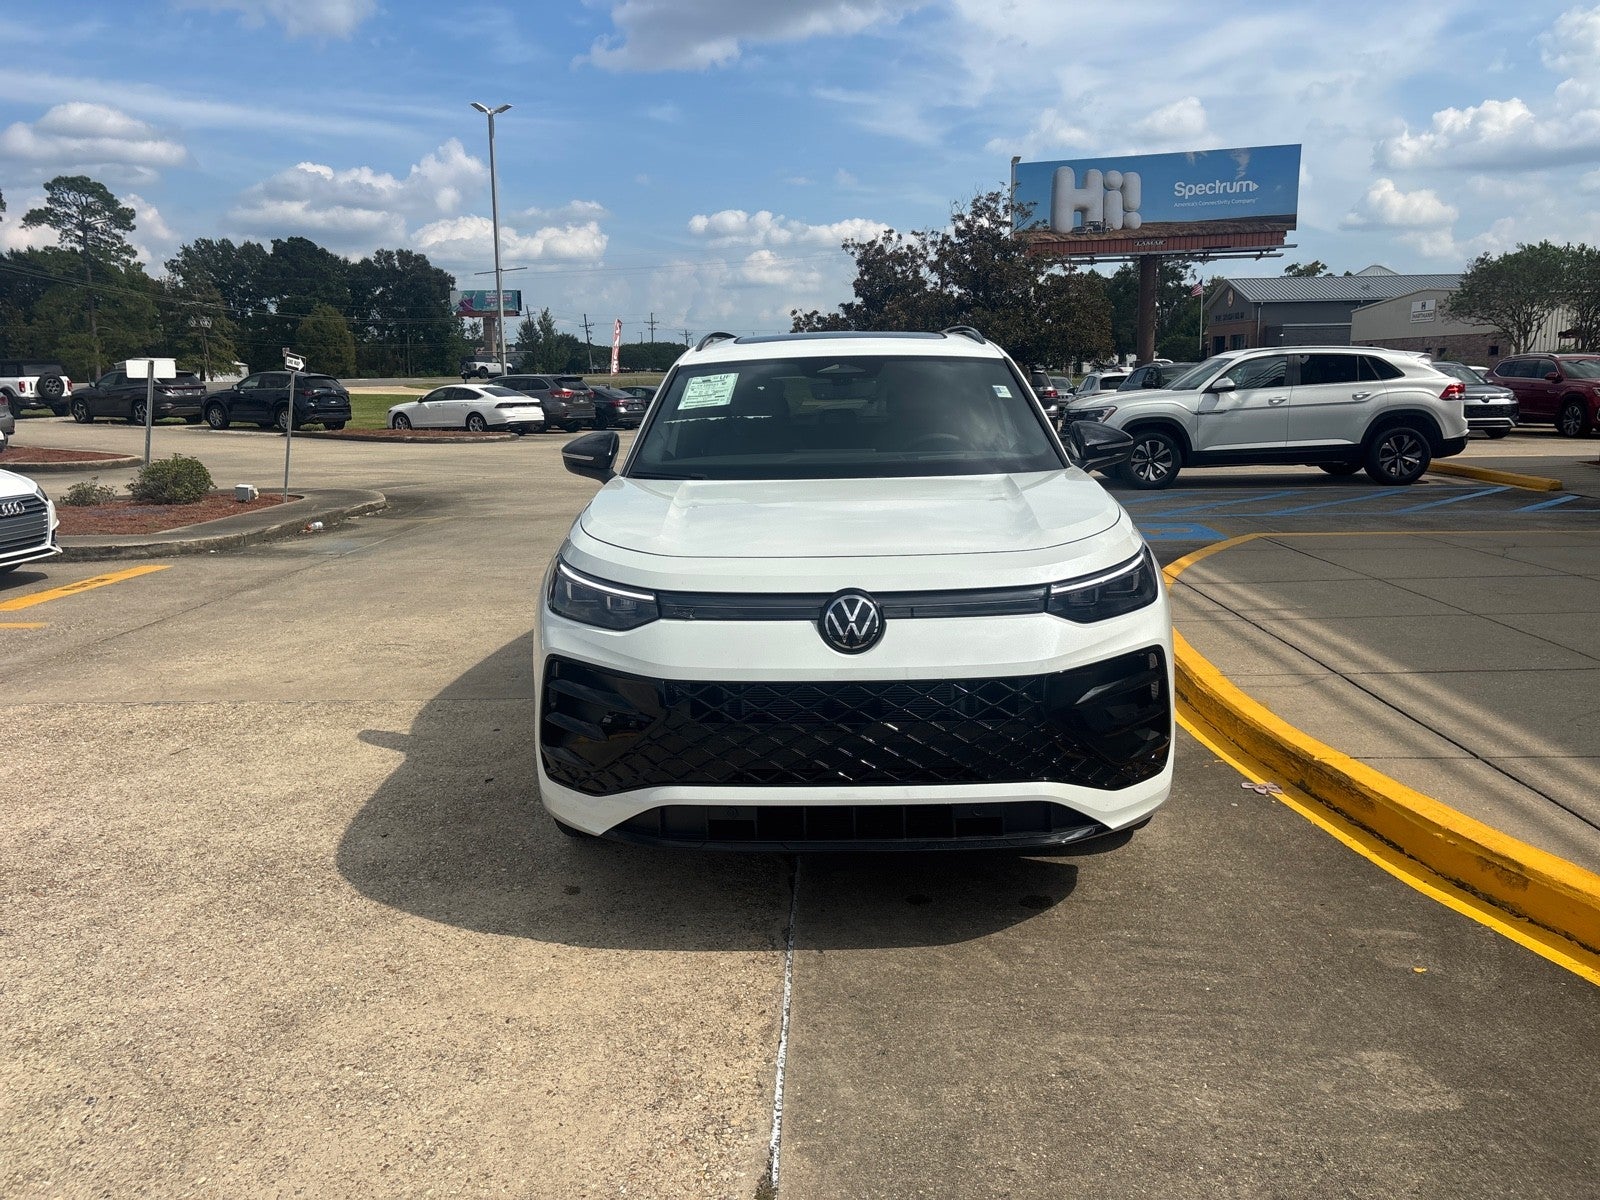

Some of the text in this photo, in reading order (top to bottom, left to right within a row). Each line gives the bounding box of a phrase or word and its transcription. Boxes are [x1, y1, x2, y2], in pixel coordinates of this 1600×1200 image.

[1174, 179, 1254, 199] Spectrum
[1053, 166, 1142, 233] Hi!
[1199, 199, 1231, 207] Connectivity
